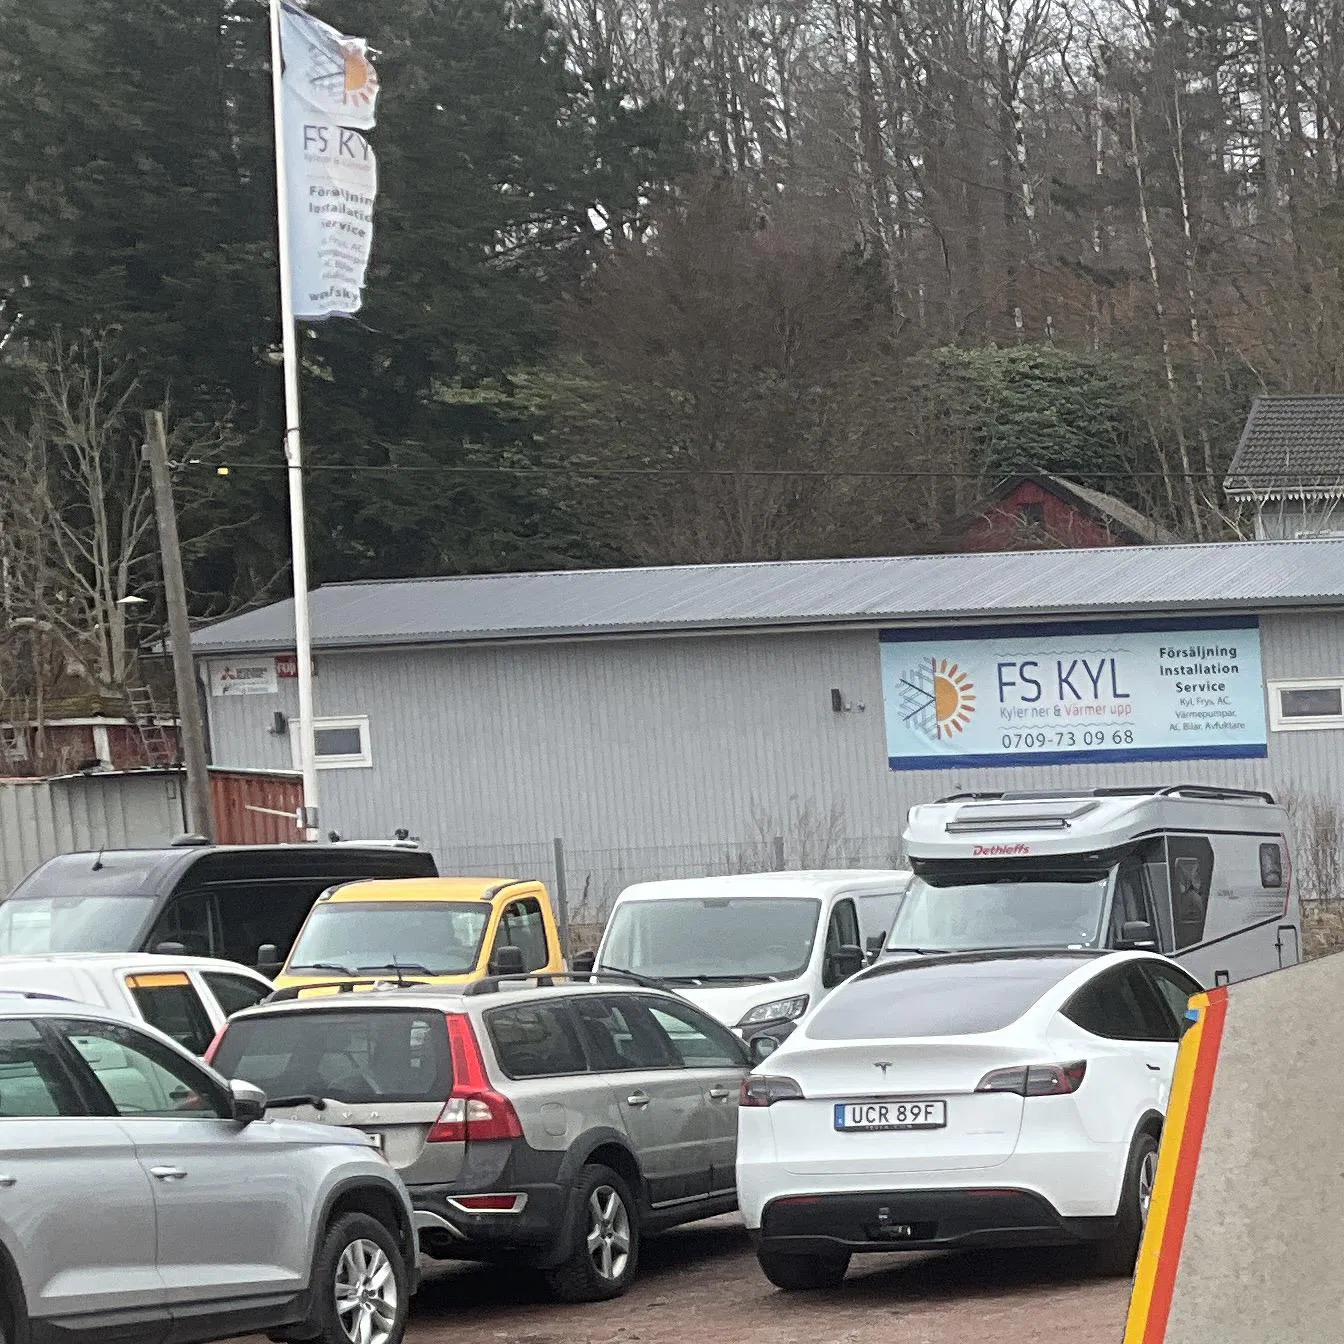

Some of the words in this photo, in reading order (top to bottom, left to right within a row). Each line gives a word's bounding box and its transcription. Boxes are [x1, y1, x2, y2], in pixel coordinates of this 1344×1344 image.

[304, 124, 328, 153] FS
[1159, 645, 1238, 660] Försäljning
[1159, 662, 1239, 676] Installation
[997, 661, 1042, 703] FS
[1056, 658, 1130, 701] KYL
[1175, 680, 1226, 693] Service
[1031, 706, 1051, 718] ner
[1053, 705, 1062, 717] &
[1063, 703, 1106, 717] Värmer
[1110, 703, 1132, 717] upp
[1002, 731, 1076, 749] 0709-73
[1083, 730, 1105, 746] 09
[1112, 729, 1134, 745] 68
[851, 1105, 890, 1124] UCR
[896, 1104, 936, 1123] 89F
